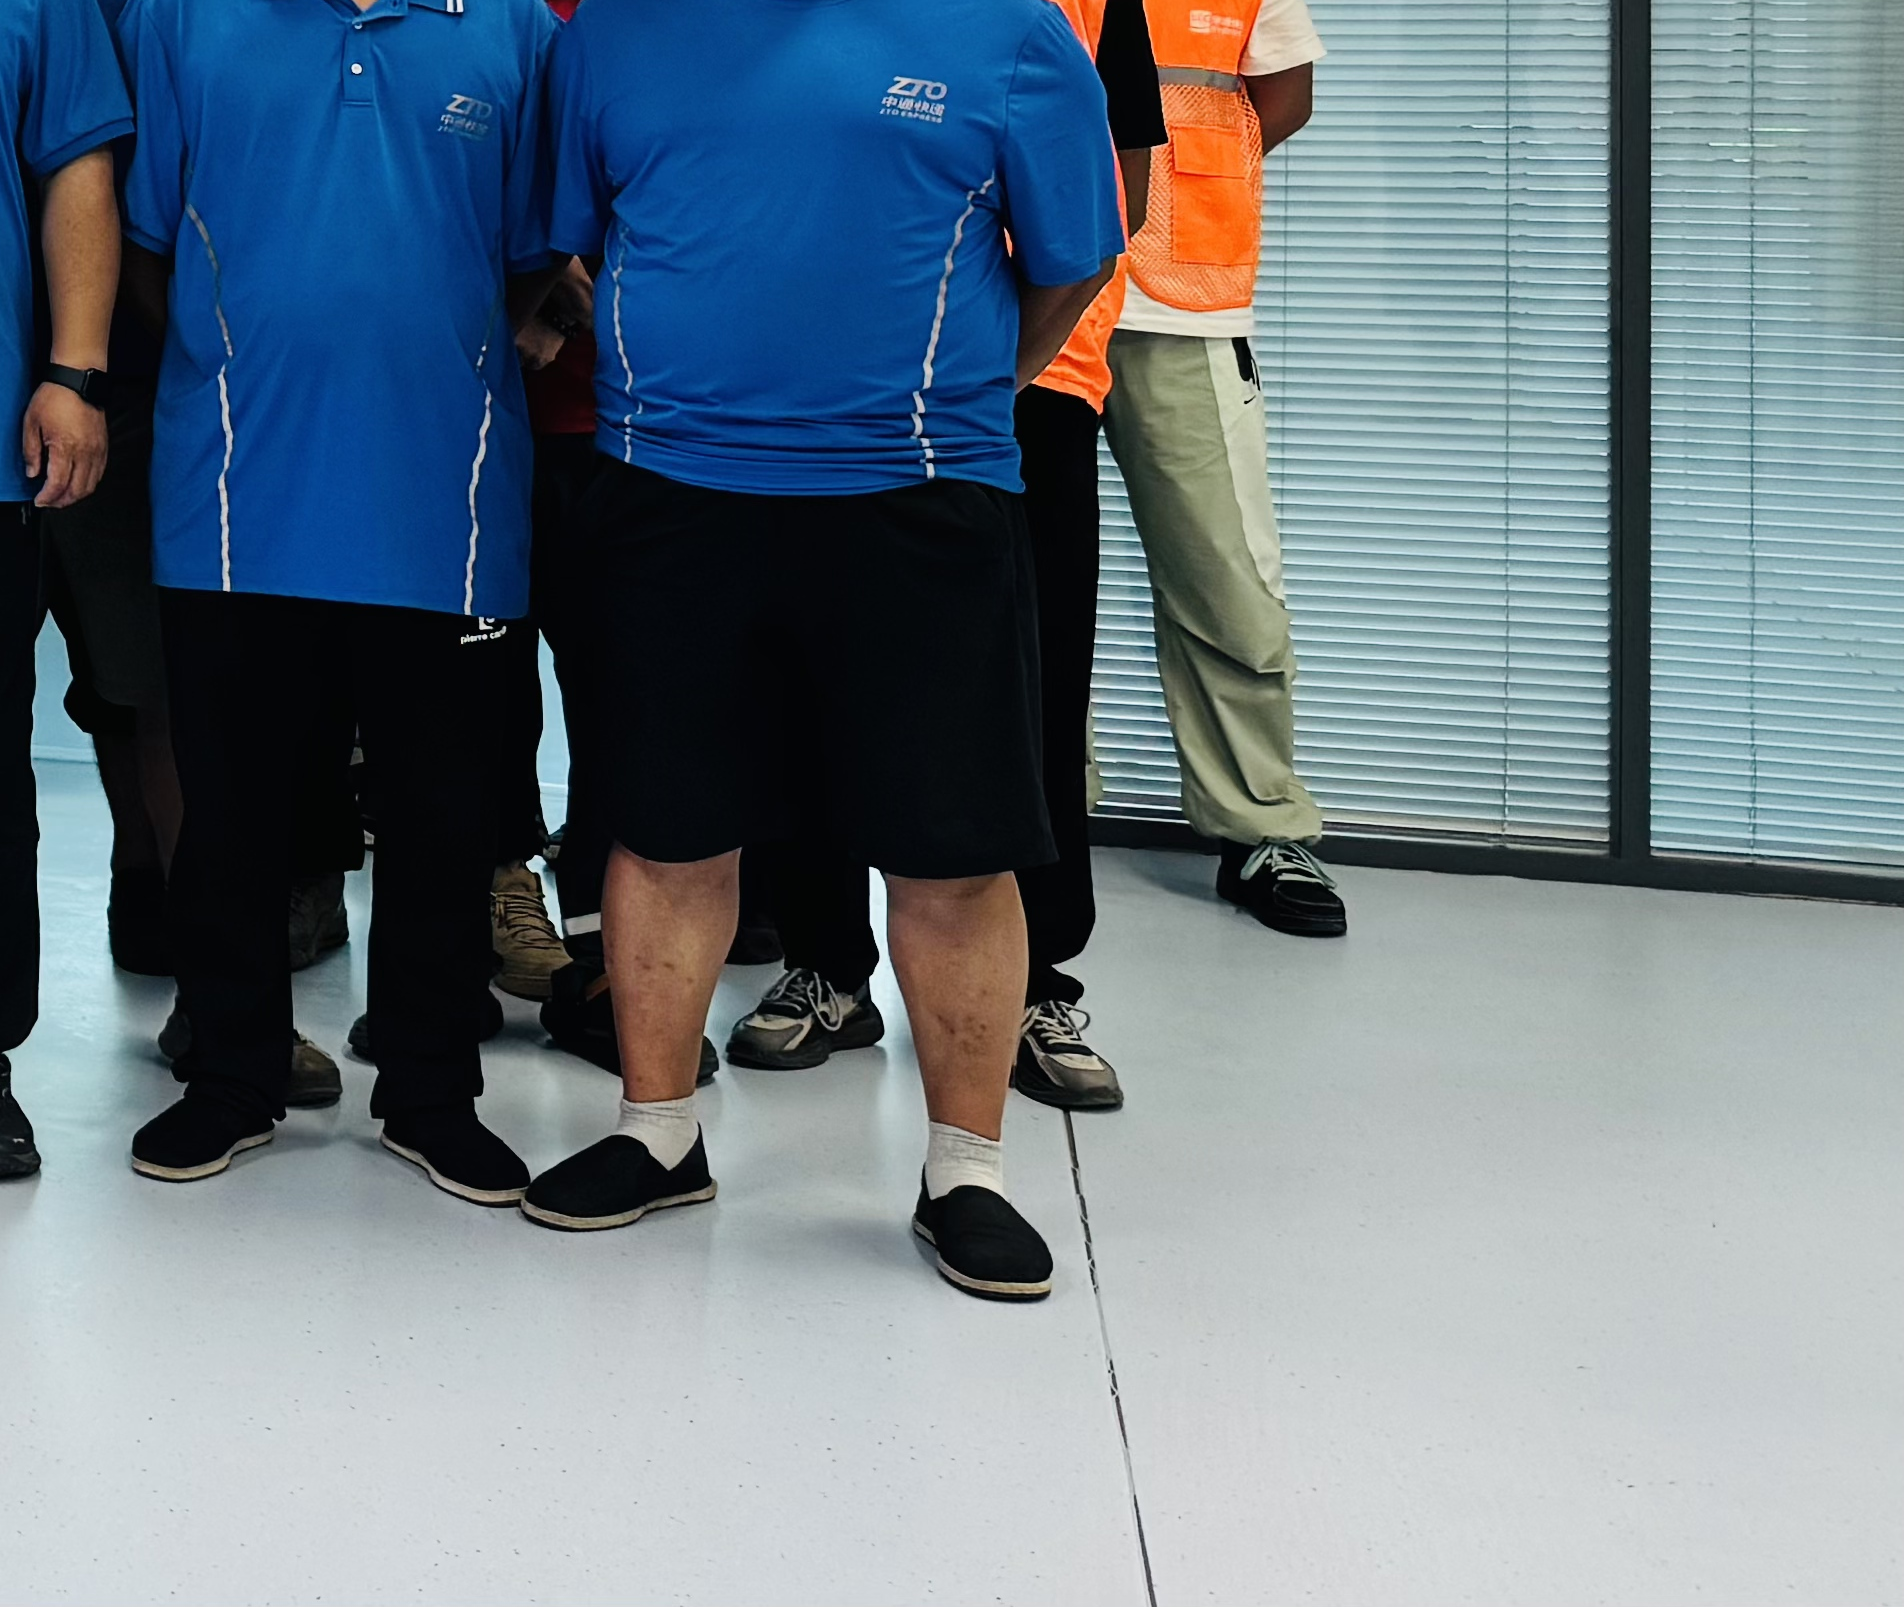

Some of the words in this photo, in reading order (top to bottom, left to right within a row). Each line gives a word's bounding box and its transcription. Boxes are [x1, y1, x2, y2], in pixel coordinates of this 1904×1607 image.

[886, 75, 948, 101] ZTO
[881, 95, 945, 117] 中通快递
